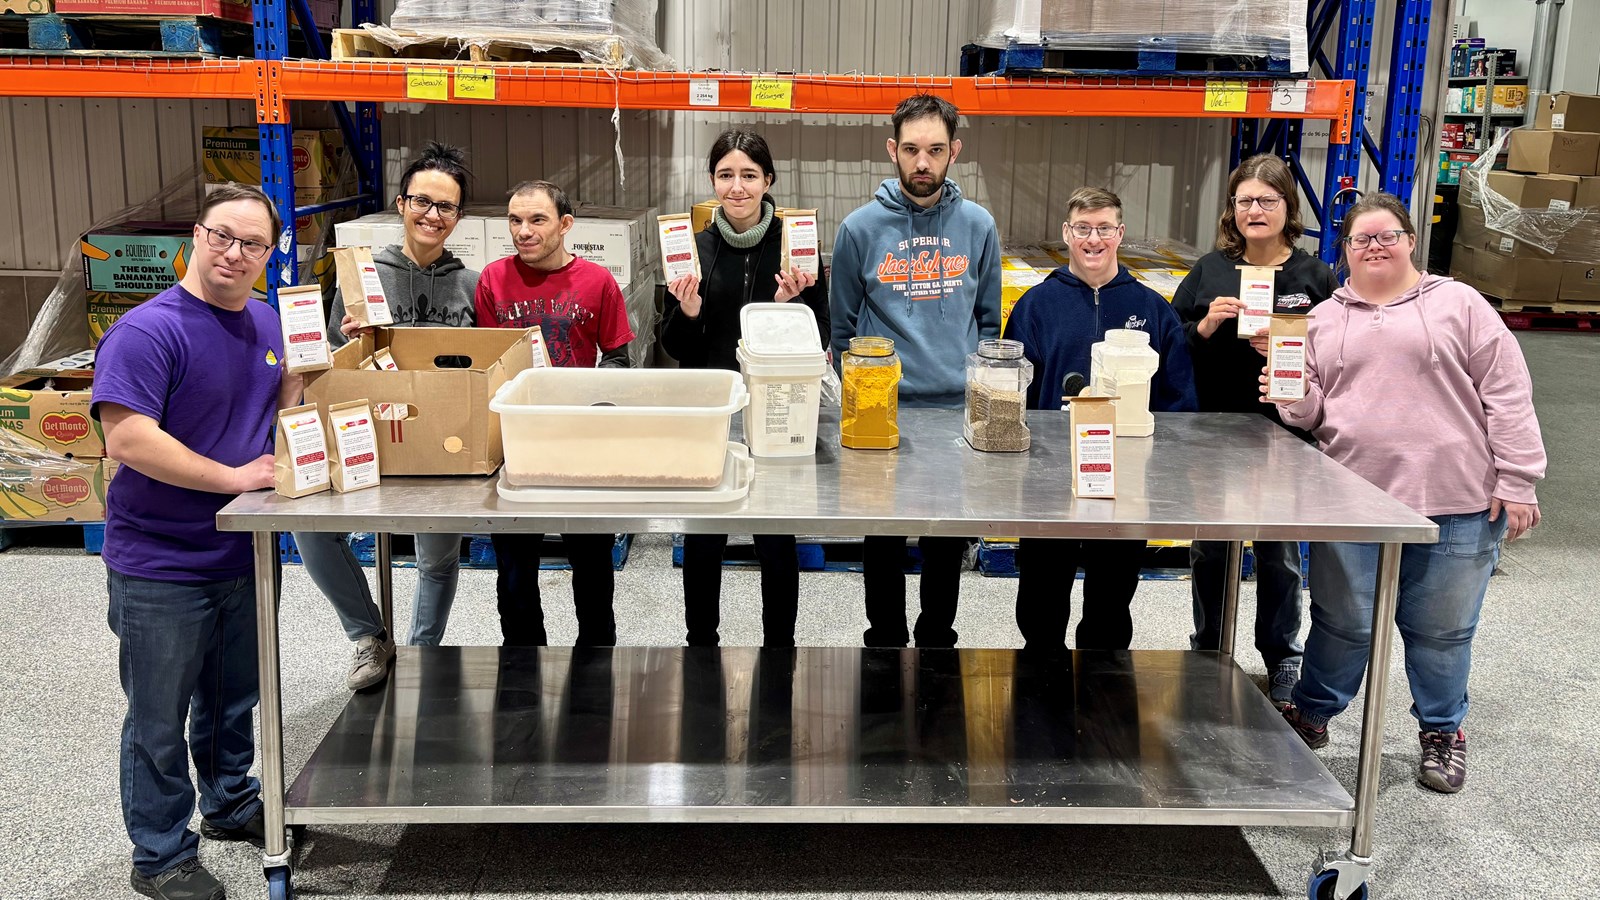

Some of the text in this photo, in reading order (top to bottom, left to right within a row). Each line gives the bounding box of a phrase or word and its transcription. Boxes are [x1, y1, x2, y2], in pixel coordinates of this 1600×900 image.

[1279, 88, 1292, 106] 3
[205, 138, 248, 149] Premium
[205, 150, 255, 161] BANANAS
[125, 244, 157, 258] EQUIFRUIT
[141, 266, 166, 274] ONLY
[113, 273, 174, 282] BANANA YOU
[114, 281, 153, 289] SHOULD
[44, 421, 87, 431] Del Monte
